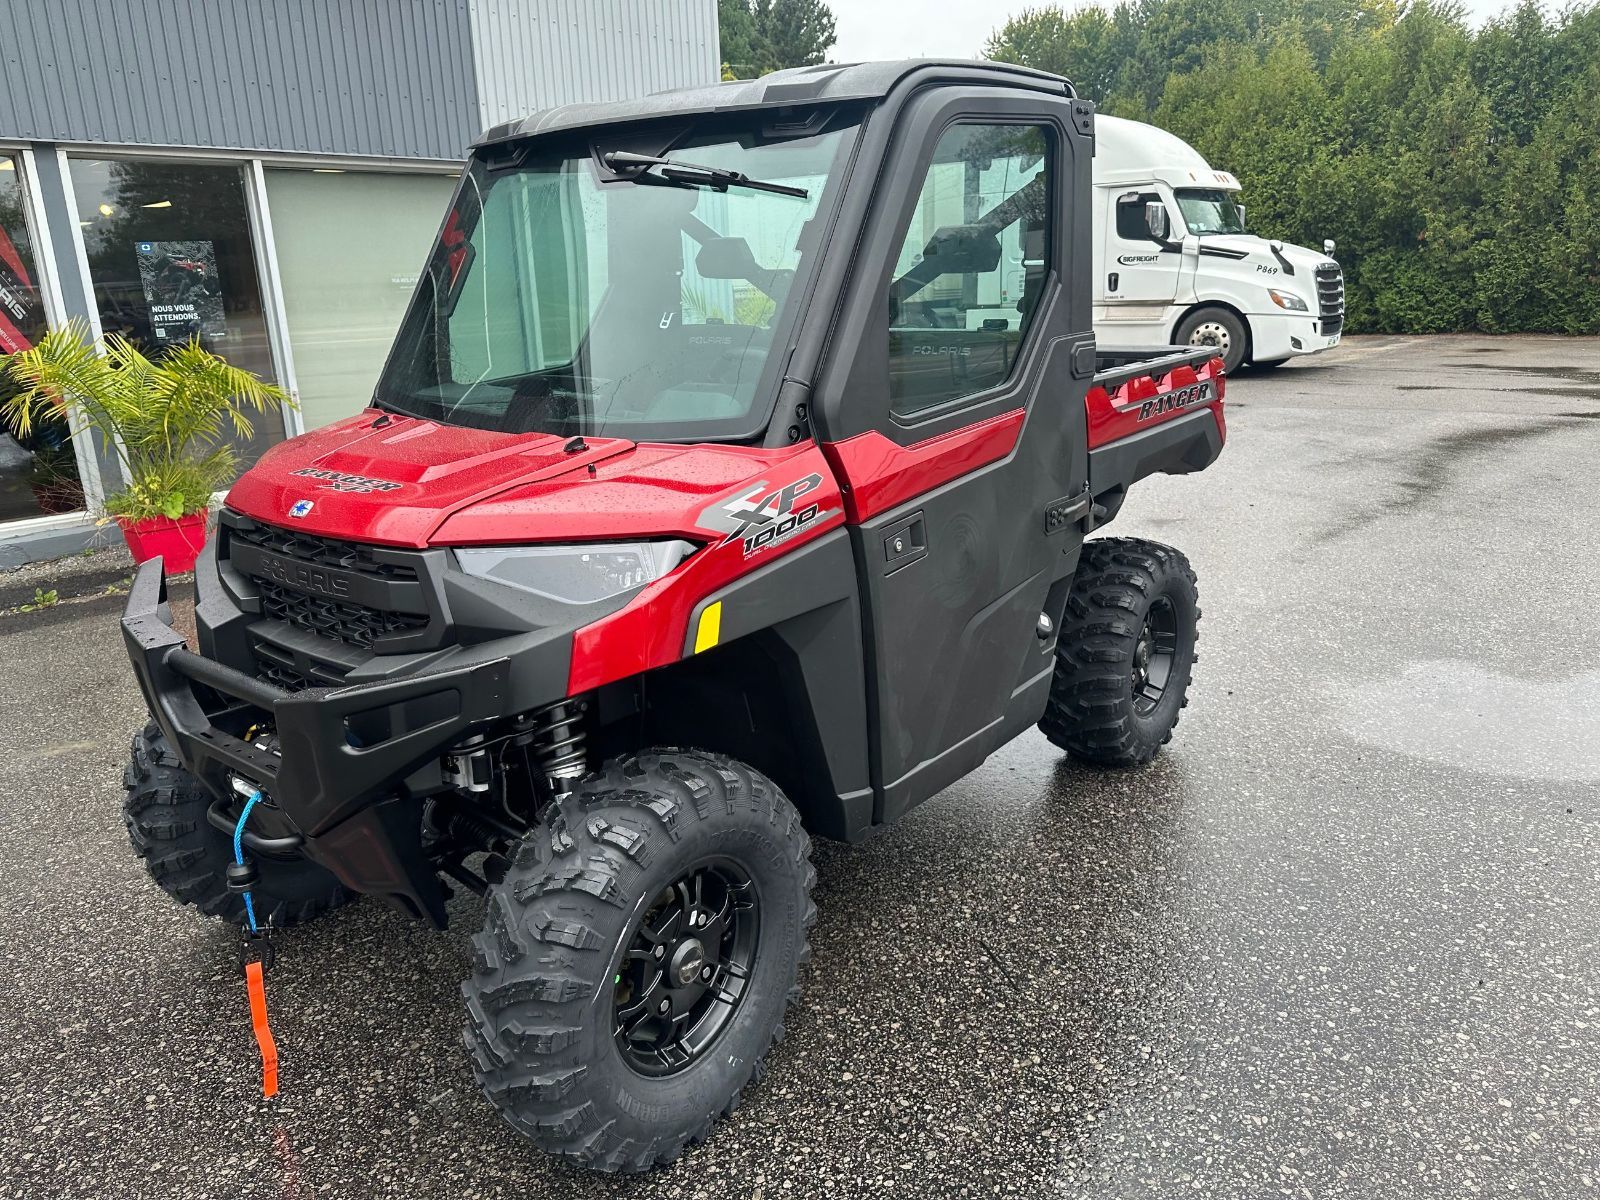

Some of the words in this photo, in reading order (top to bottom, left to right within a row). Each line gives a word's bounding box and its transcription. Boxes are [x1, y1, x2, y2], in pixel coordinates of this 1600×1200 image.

[1256, 264, 1278, 276] P869
[152, 304, 173, 313] NOUS
[174, 304, 195, 312] VOUS
[153, 312, 201, 322] ATTENDONS.
[688, 336, 736, 345] POLARIS
[912, 345, 971, 356] POLARIS
[1137, 382, 1210, 422] RANGER
[288, 467, 403, 492] RANGER
[715, 472, 824, 550] XP
[743, 503, 819, 557] 1000
[261, 558, 350, 598] POLARIS
